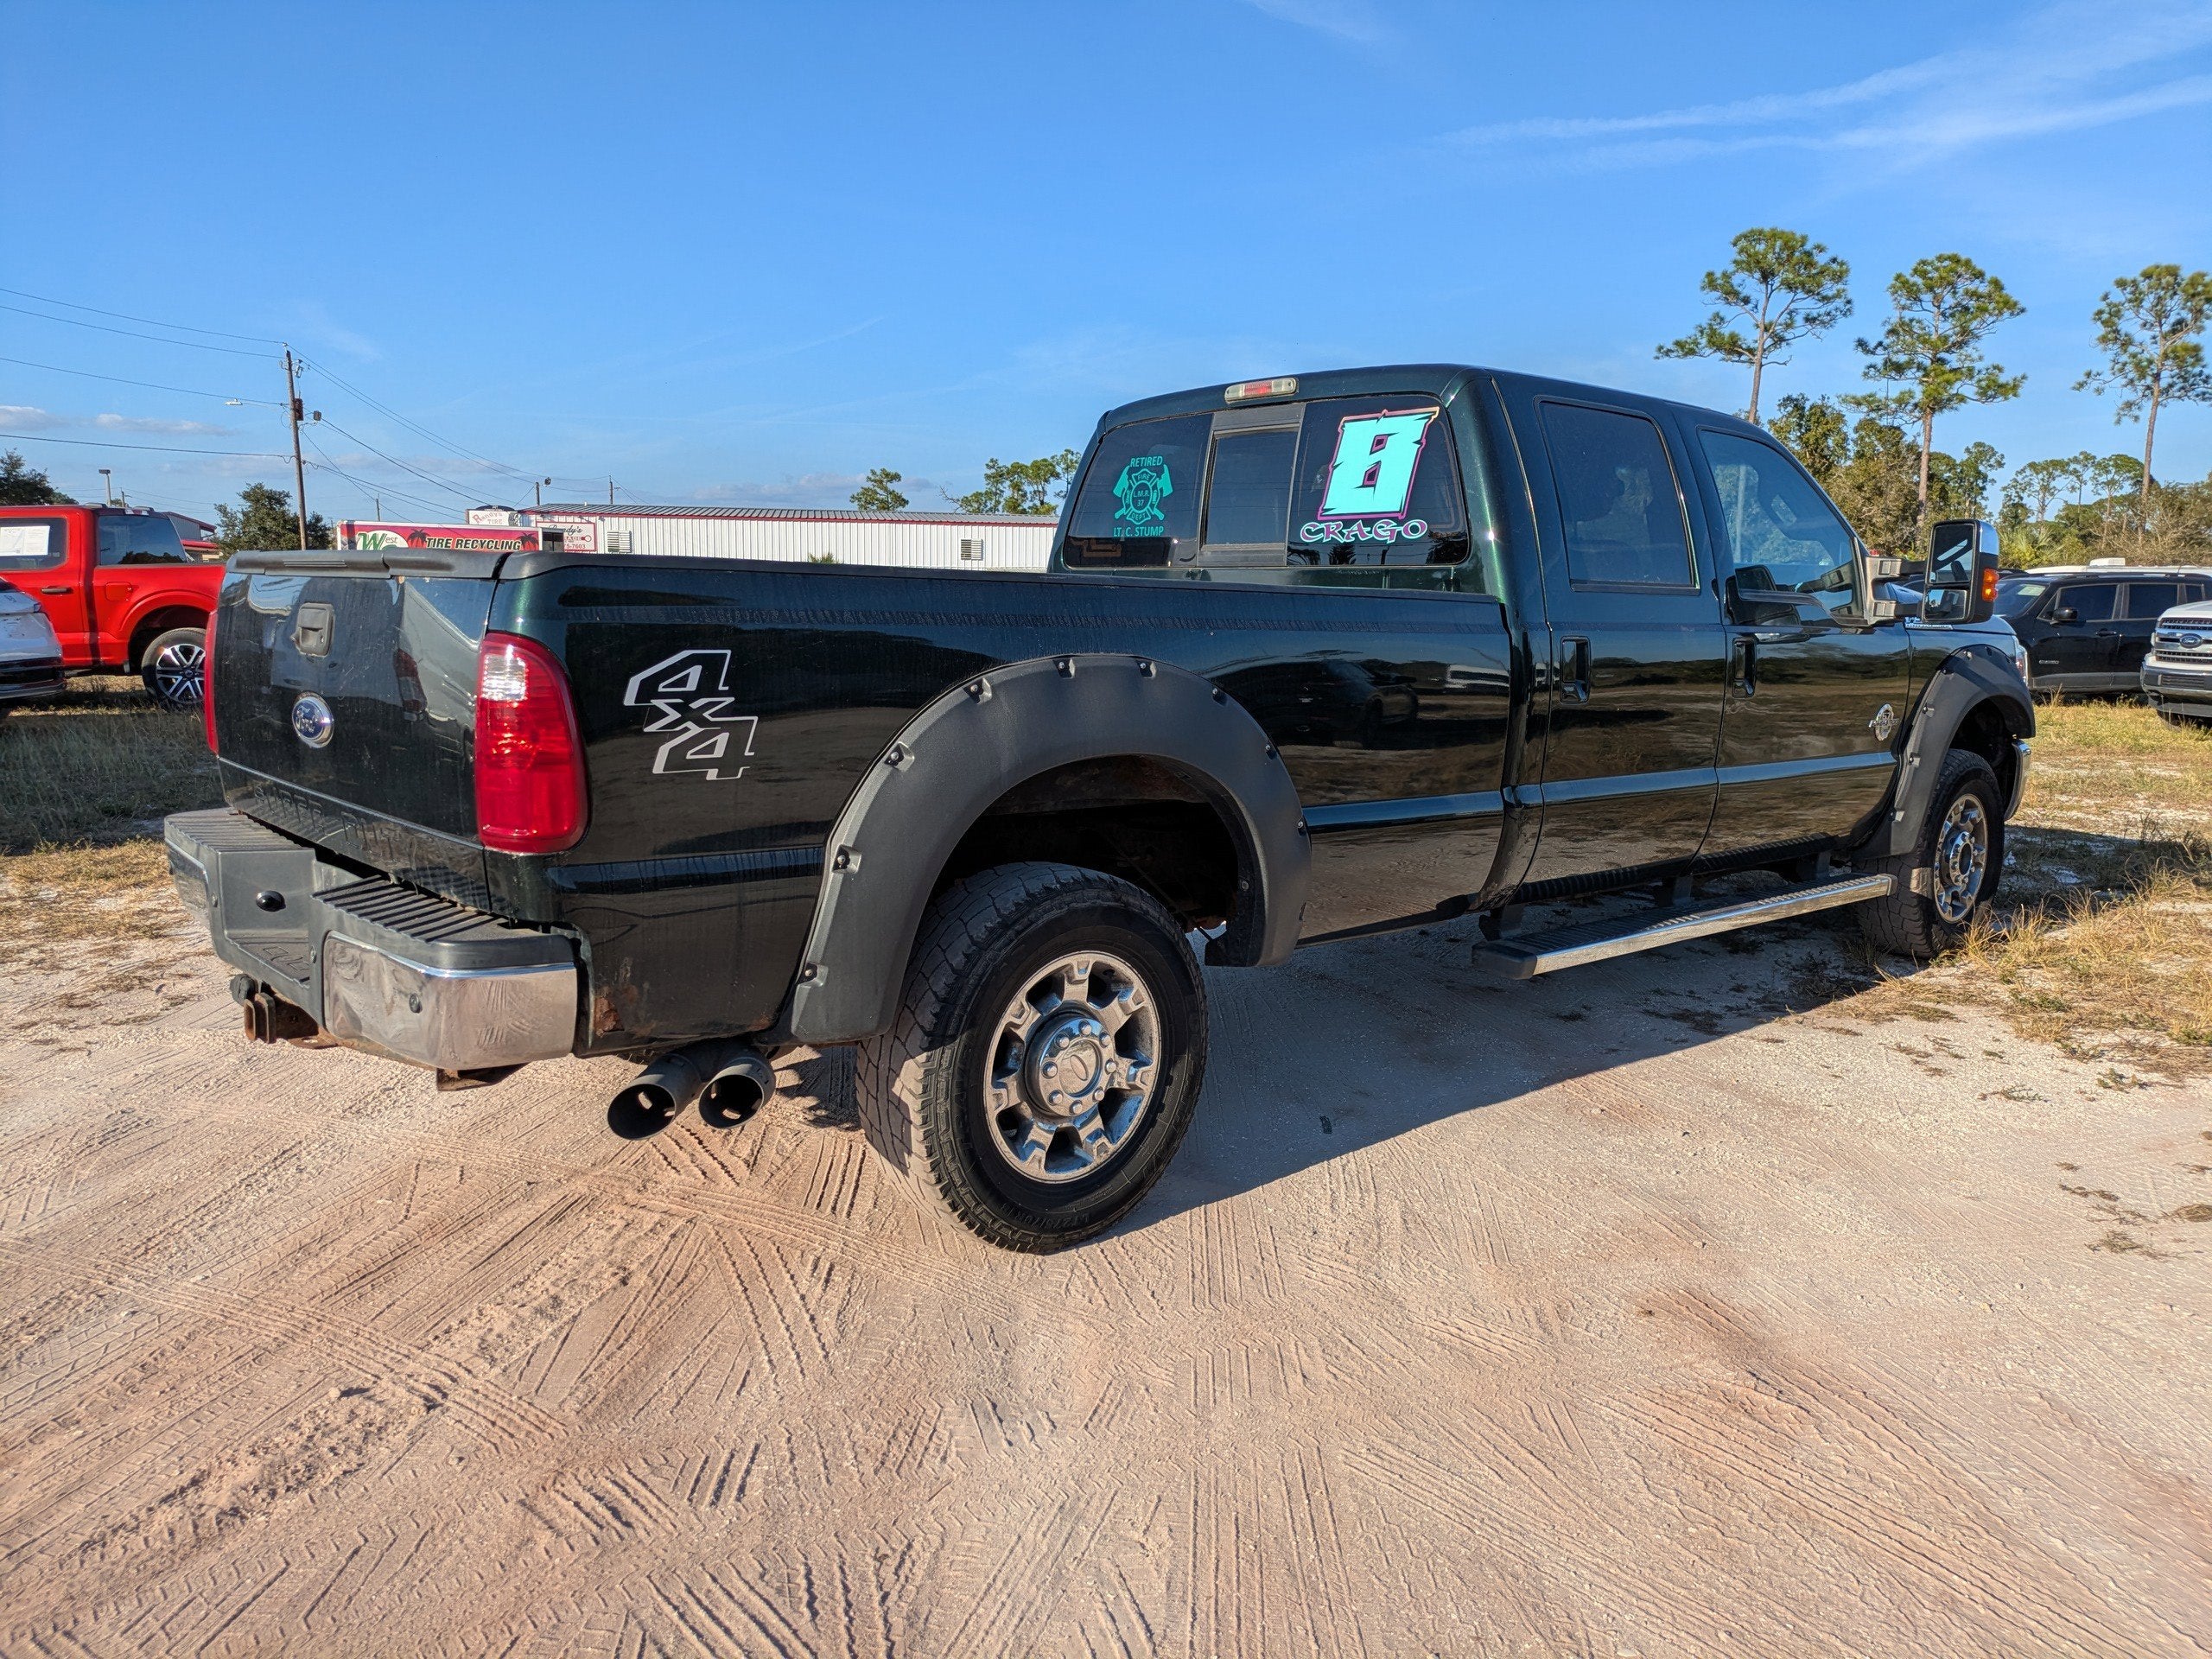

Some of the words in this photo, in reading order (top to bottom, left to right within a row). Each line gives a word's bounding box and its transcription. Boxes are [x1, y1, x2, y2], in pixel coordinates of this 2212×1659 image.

[1130, 456, 1163, 467] RETIRED
[1318, 406, 1440, 521] 8
[1135, 525, 1164, 537] STUMP
[1300, 518, 1428, 543] CRAGO
[357, 532, 398, 550] West
[426, 537, 453, 549] TIRE
[454, 538, 522, 550] RECYCLING
